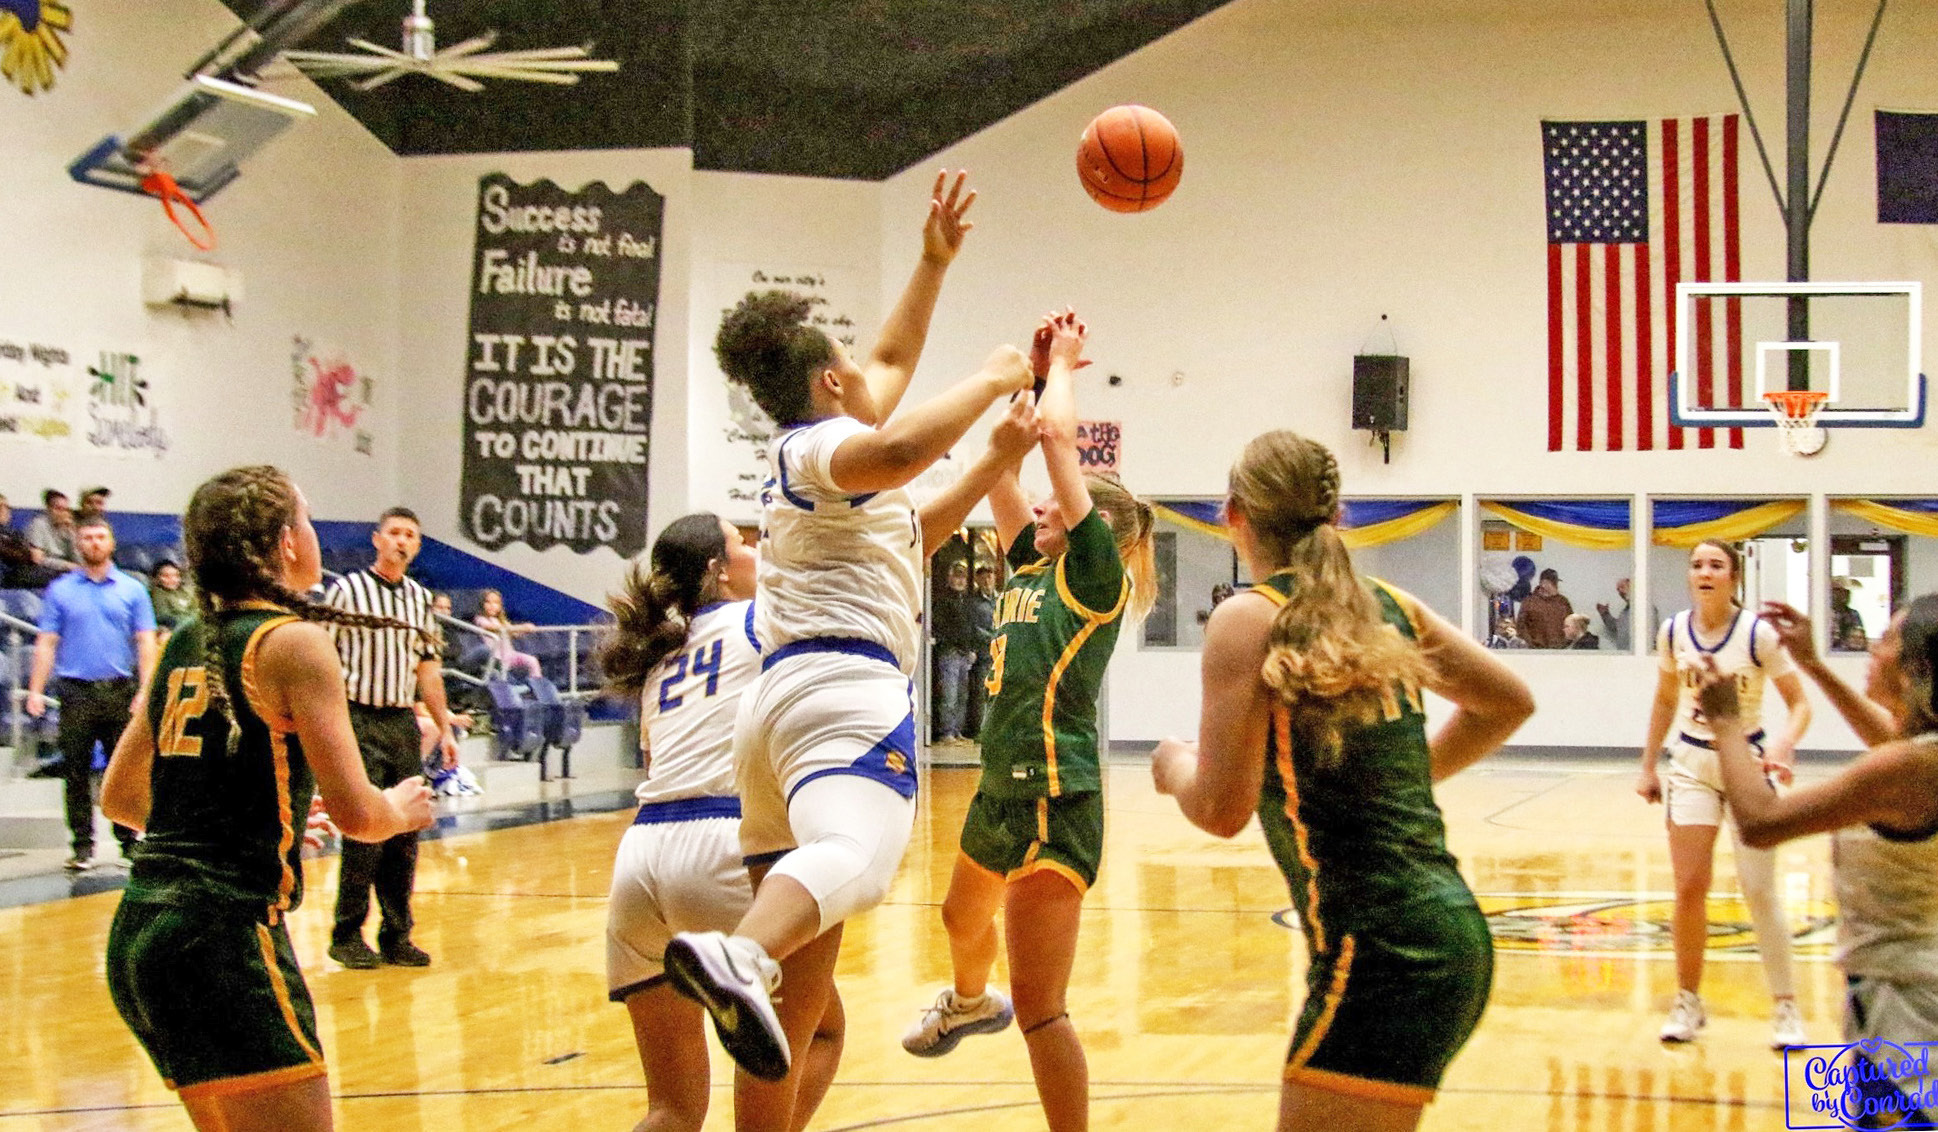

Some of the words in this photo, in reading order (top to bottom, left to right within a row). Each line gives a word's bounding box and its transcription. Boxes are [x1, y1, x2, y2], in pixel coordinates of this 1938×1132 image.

[481, 184, 603, 234] Success
[557, 233, 577, 253] is
[583, 234, 612, 256] not
[479, 249, 593, 296] Failure
[554, 300, 572, 321] is
[579, 299, 611, 325] not
[473, 334, 526, 373] IT
[529, 335, 578, 377] IS
[586, 337, 650, 382] THE
[468, 378, 648, 433] COURAGE
[475, 431, 518, 459] TO
[521, 429, 649, 464] CONTINUE
[515, 464, 594, 497] THAT
[471, 494, 621, 543] COUNTS
[658, 637, 724, 716] 24
[158, 666, 210, 758] 12
